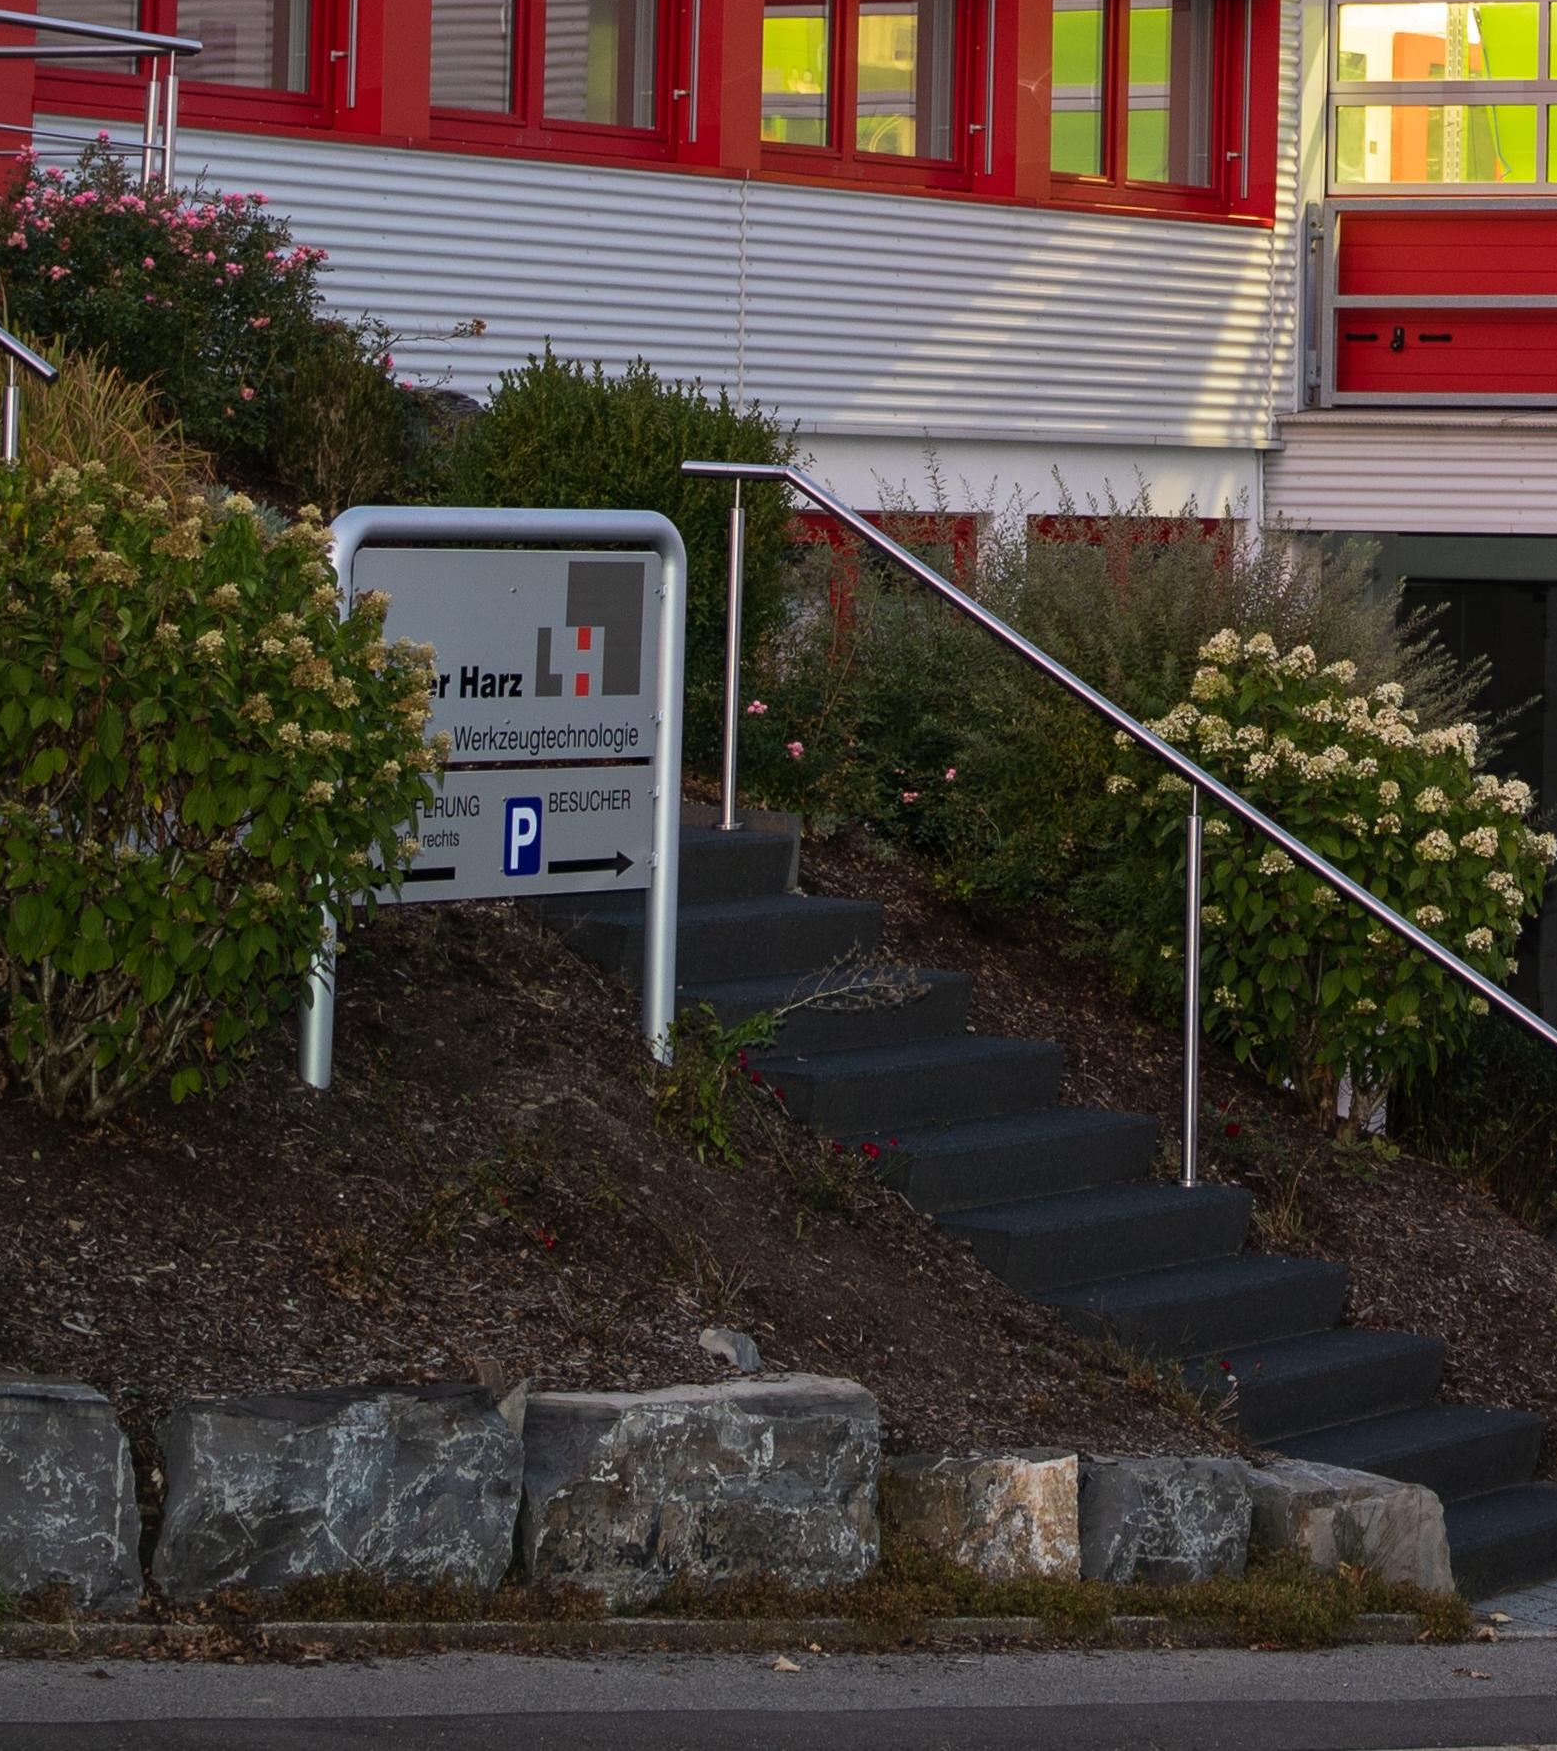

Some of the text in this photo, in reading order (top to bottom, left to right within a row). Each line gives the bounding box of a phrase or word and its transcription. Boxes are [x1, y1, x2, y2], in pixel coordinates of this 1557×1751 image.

[459, 665, 523, 699] Harz
[454, 721, 639, 756] Werkzeugtechnologie
[549, 789, 632, 813] BESUCHER
[423, 829, 460, 848] rechts
[510, 806, 538, 870] P
